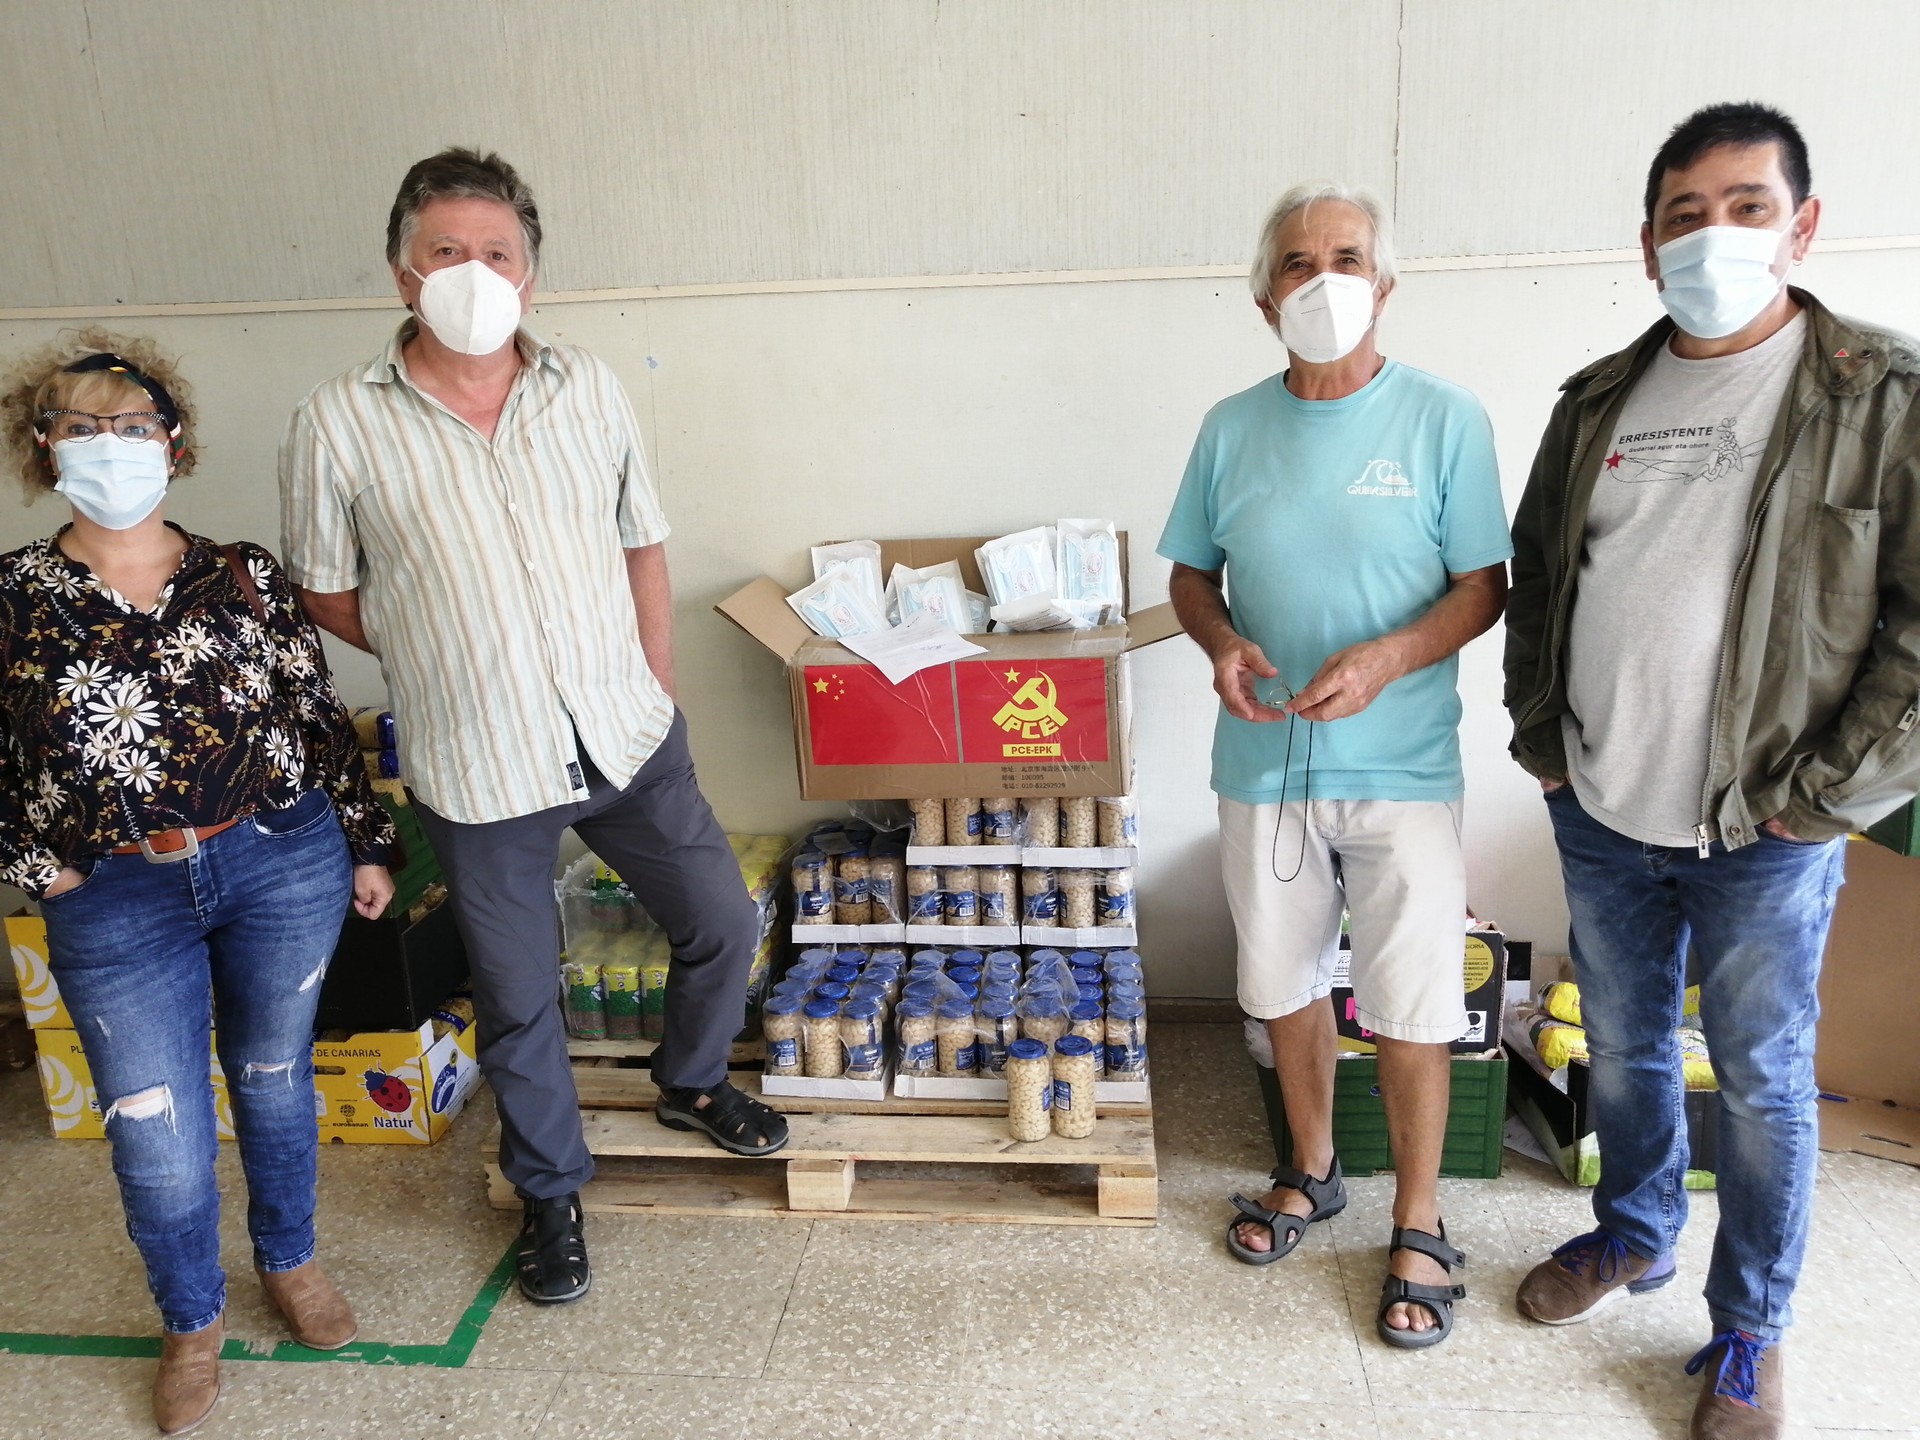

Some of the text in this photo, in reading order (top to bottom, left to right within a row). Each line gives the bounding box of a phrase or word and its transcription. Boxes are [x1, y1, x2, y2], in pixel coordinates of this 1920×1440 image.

[1618, 426, 1713, 444] ERRESISTENTE
[1346, 485, 1418, 497] QUIKSILVER
[1001, 716, 1060, 739] PCE
[1011, 746, 1052, 755] PCE-EPK
[316, 1049, 381, 1057] DE CANARIAS
[373, 1116, 414, 1128] Natur
